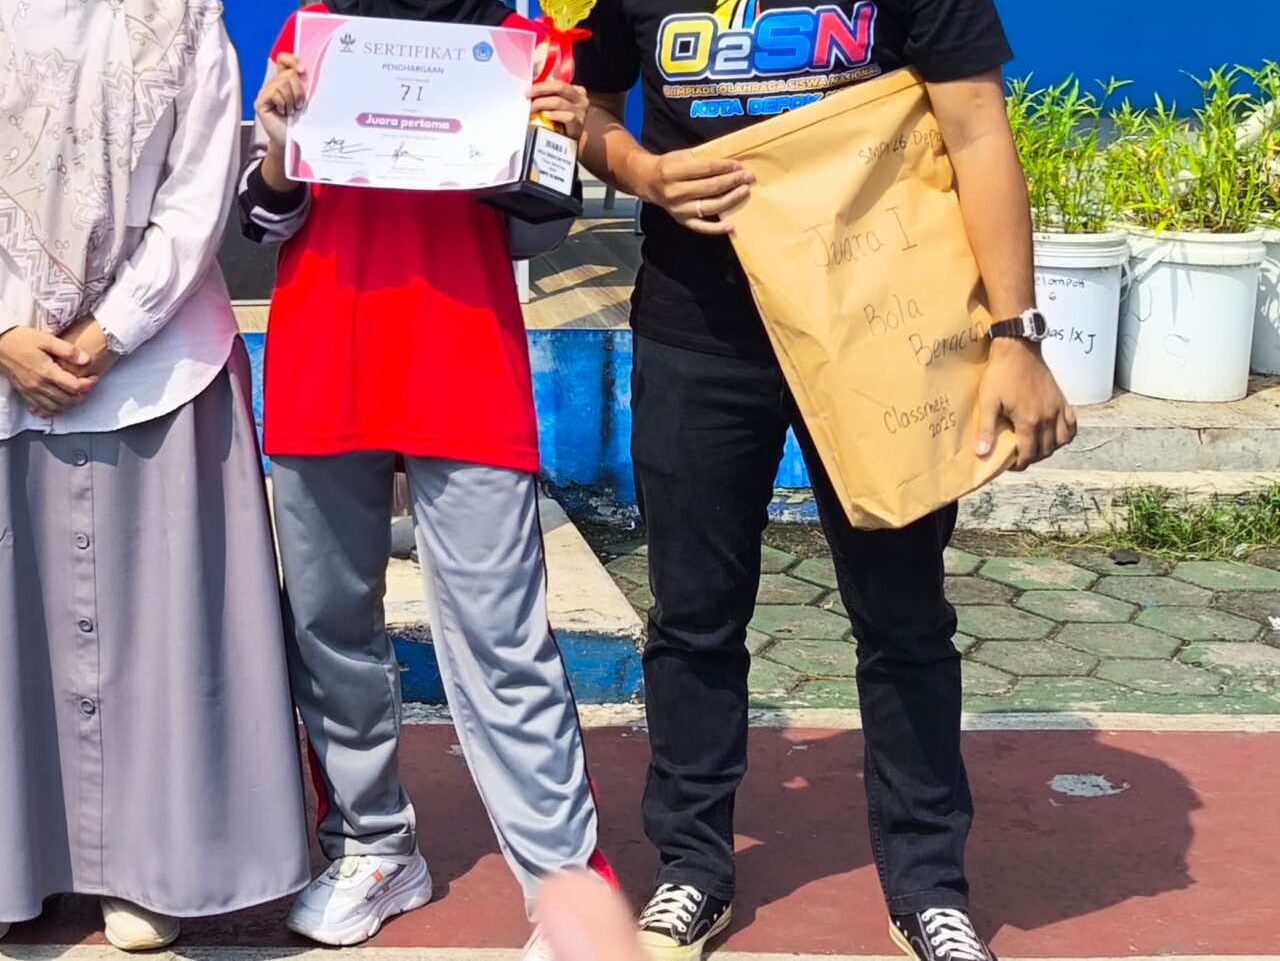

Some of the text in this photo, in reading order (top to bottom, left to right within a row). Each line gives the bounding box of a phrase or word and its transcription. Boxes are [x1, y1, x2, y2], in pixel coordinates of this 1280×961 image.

[363, 42, 466, 61] SERTIFIKAT
[382, 63, 444, 74] PENGHARGAAN
[664, 65, 881, 98] OLIMPIADE OLAHRAGA SISWA NASIONAL
[690, 98, 744, 118] KOTA
[366, 115, 450, 130] Juara pertama
[913, 129, 942, 149] Depo
[804, 222, 885, 270] Juara
[864, 294, 923, 336] Bola
[908, 320, 986, 366] Beracun
[883, 394, 950, 434] Classmeet
[928, 412, 957, 438] 2025
